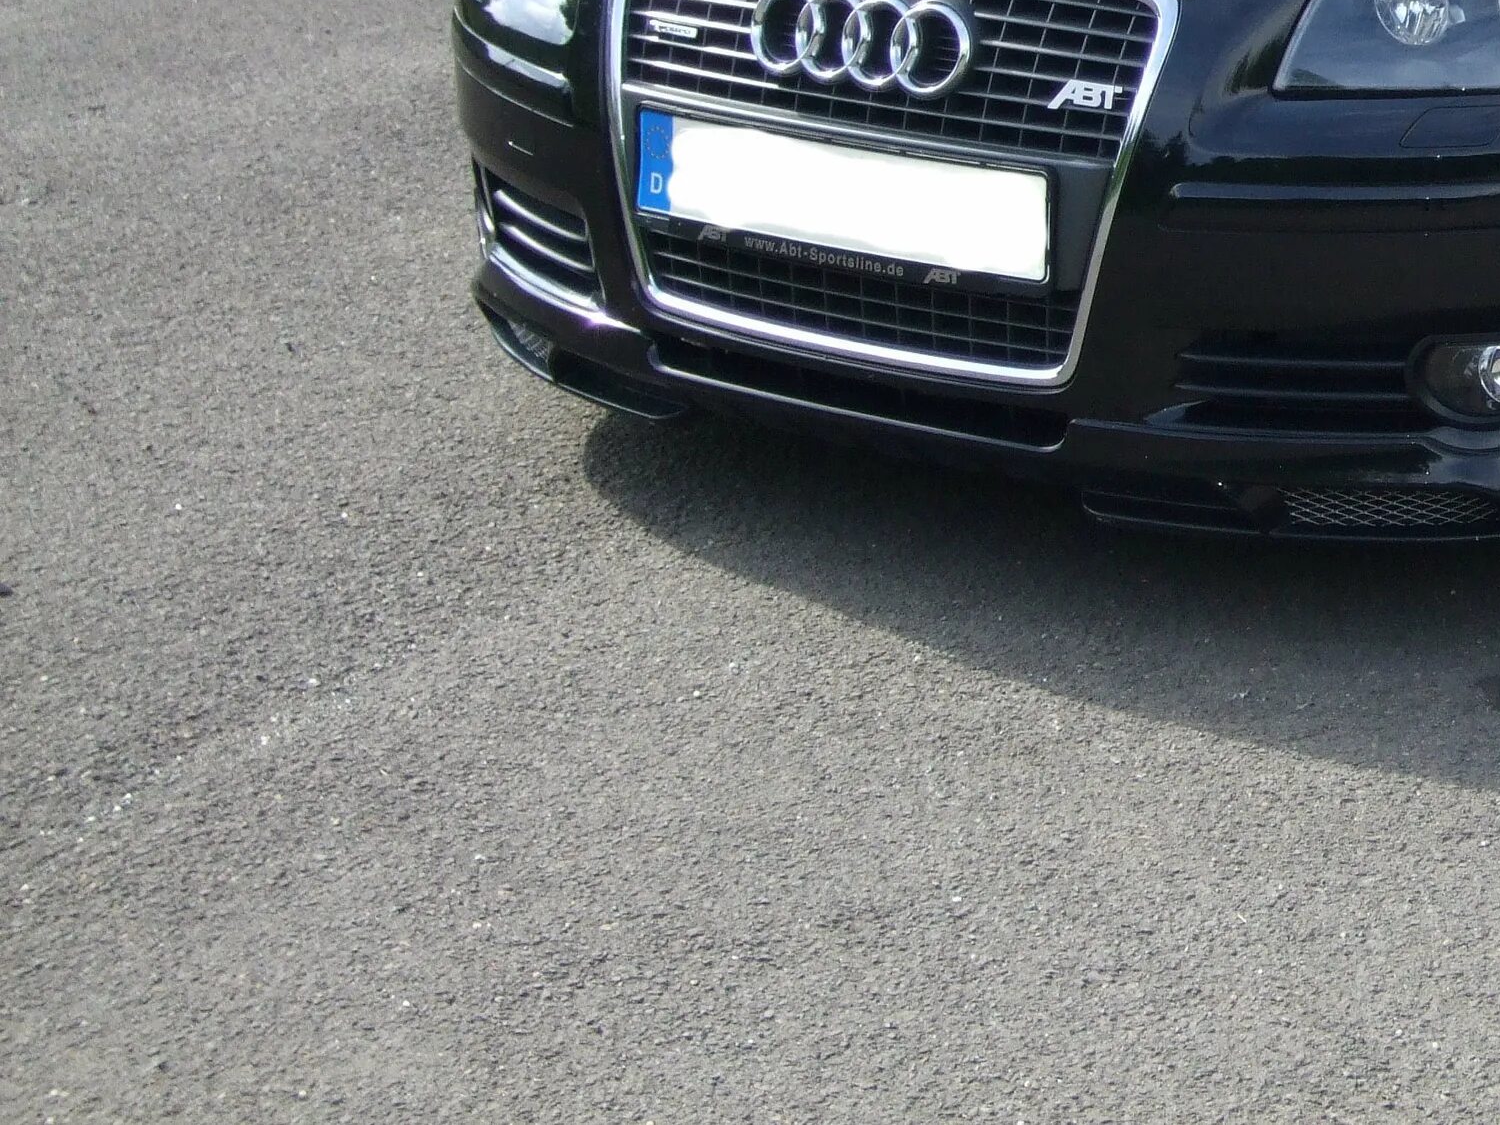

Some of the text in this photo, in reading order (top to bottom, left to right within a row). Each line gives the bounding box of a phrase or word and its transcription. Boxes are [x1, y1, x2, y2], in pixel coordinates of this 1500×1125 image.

[1047, 79, 1122, 110] ABT
[650, 172, 663, 194] D
[697, 224, 961, 284] ABT www.Abt-Sportsline.de ABT
